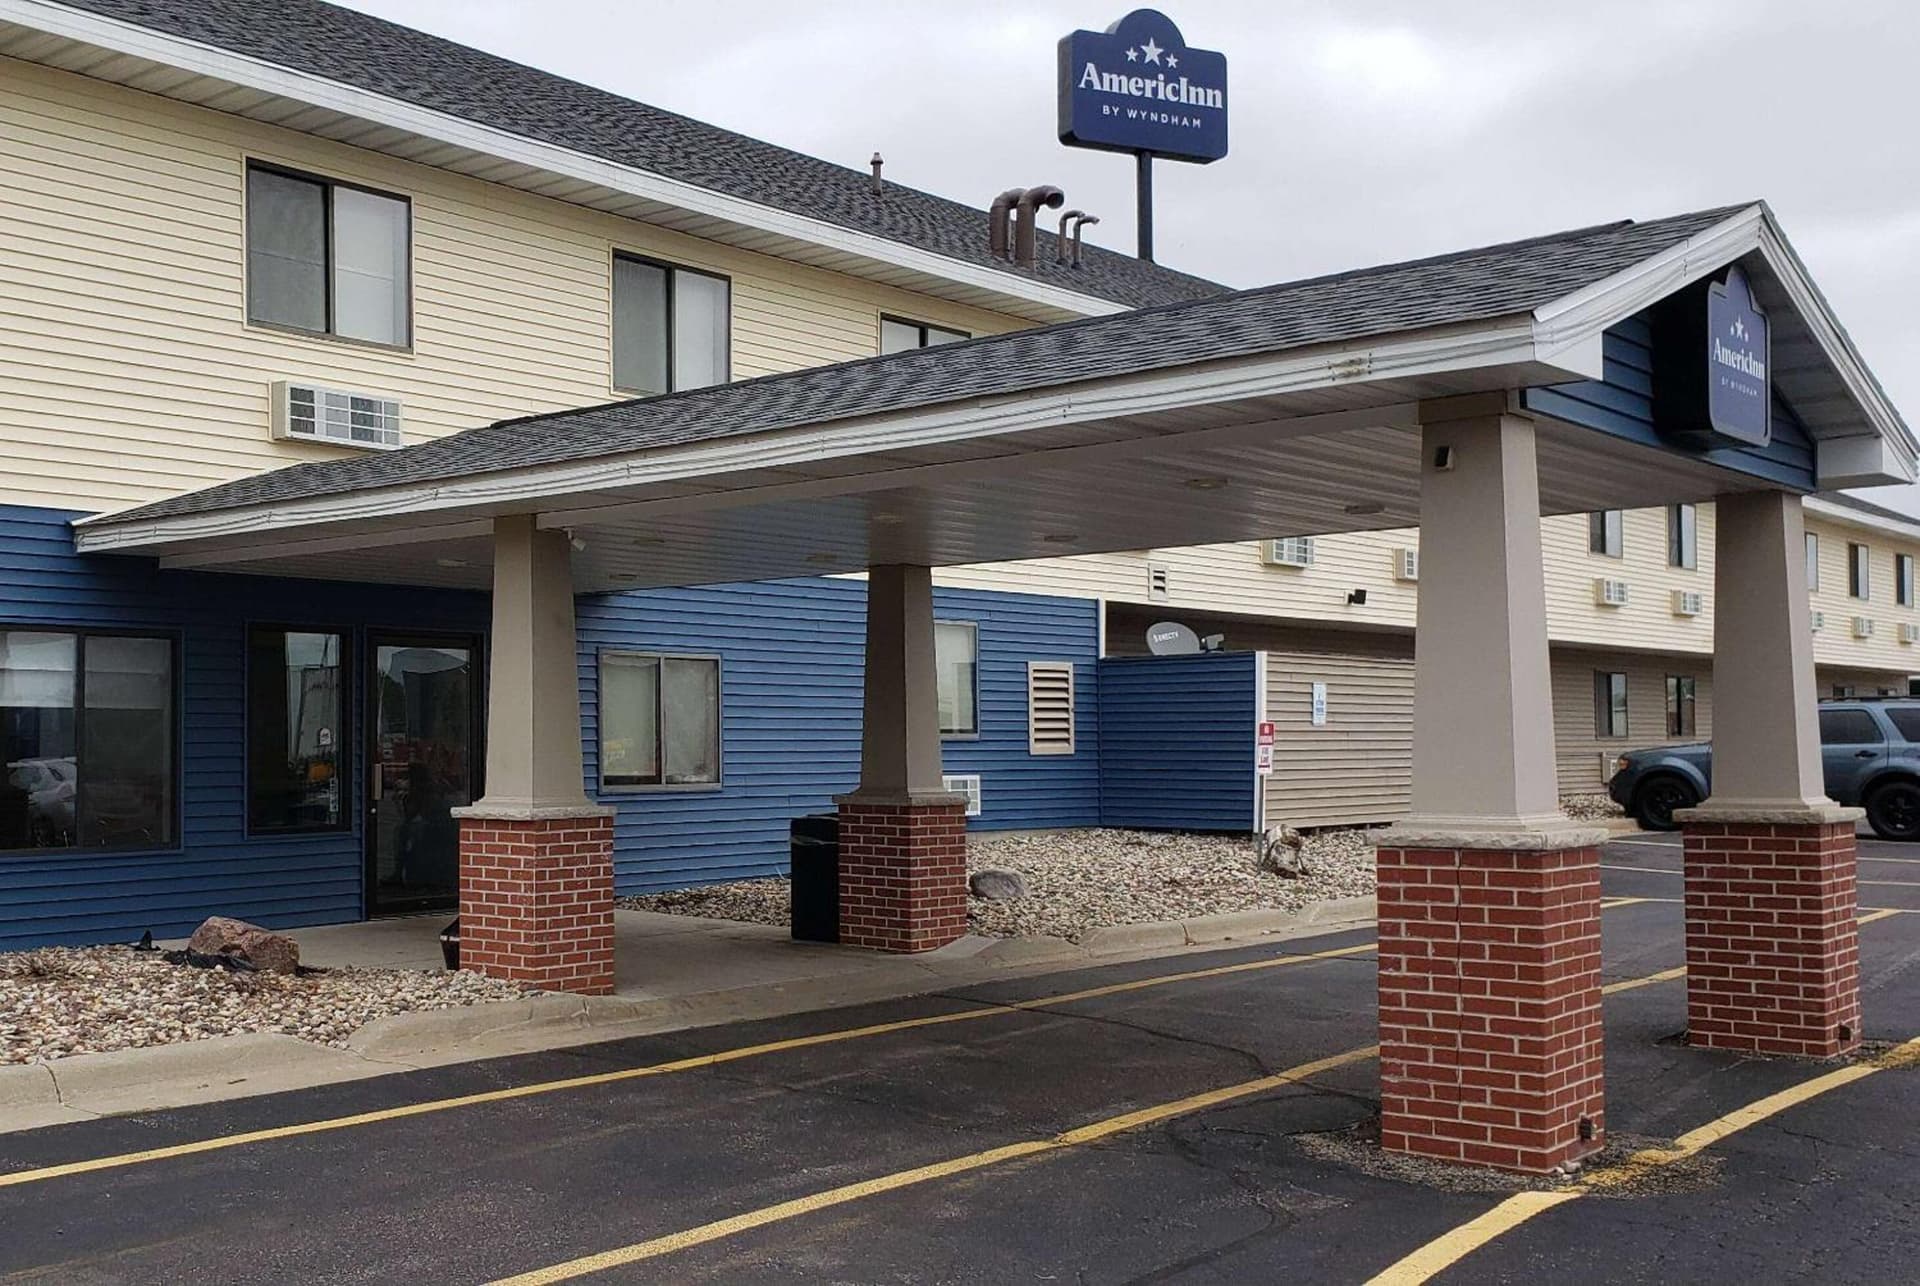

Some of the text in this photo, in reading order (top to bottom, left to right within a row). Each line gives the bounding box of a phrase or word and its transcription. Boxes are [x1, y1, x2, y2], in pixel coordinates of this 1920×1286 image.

[1078, 62, 1223, 109] AmericInn
[1102, 105, 1201, 128] BY WYNDHAM
[1713, 337, 1765, 380] AmericInn
